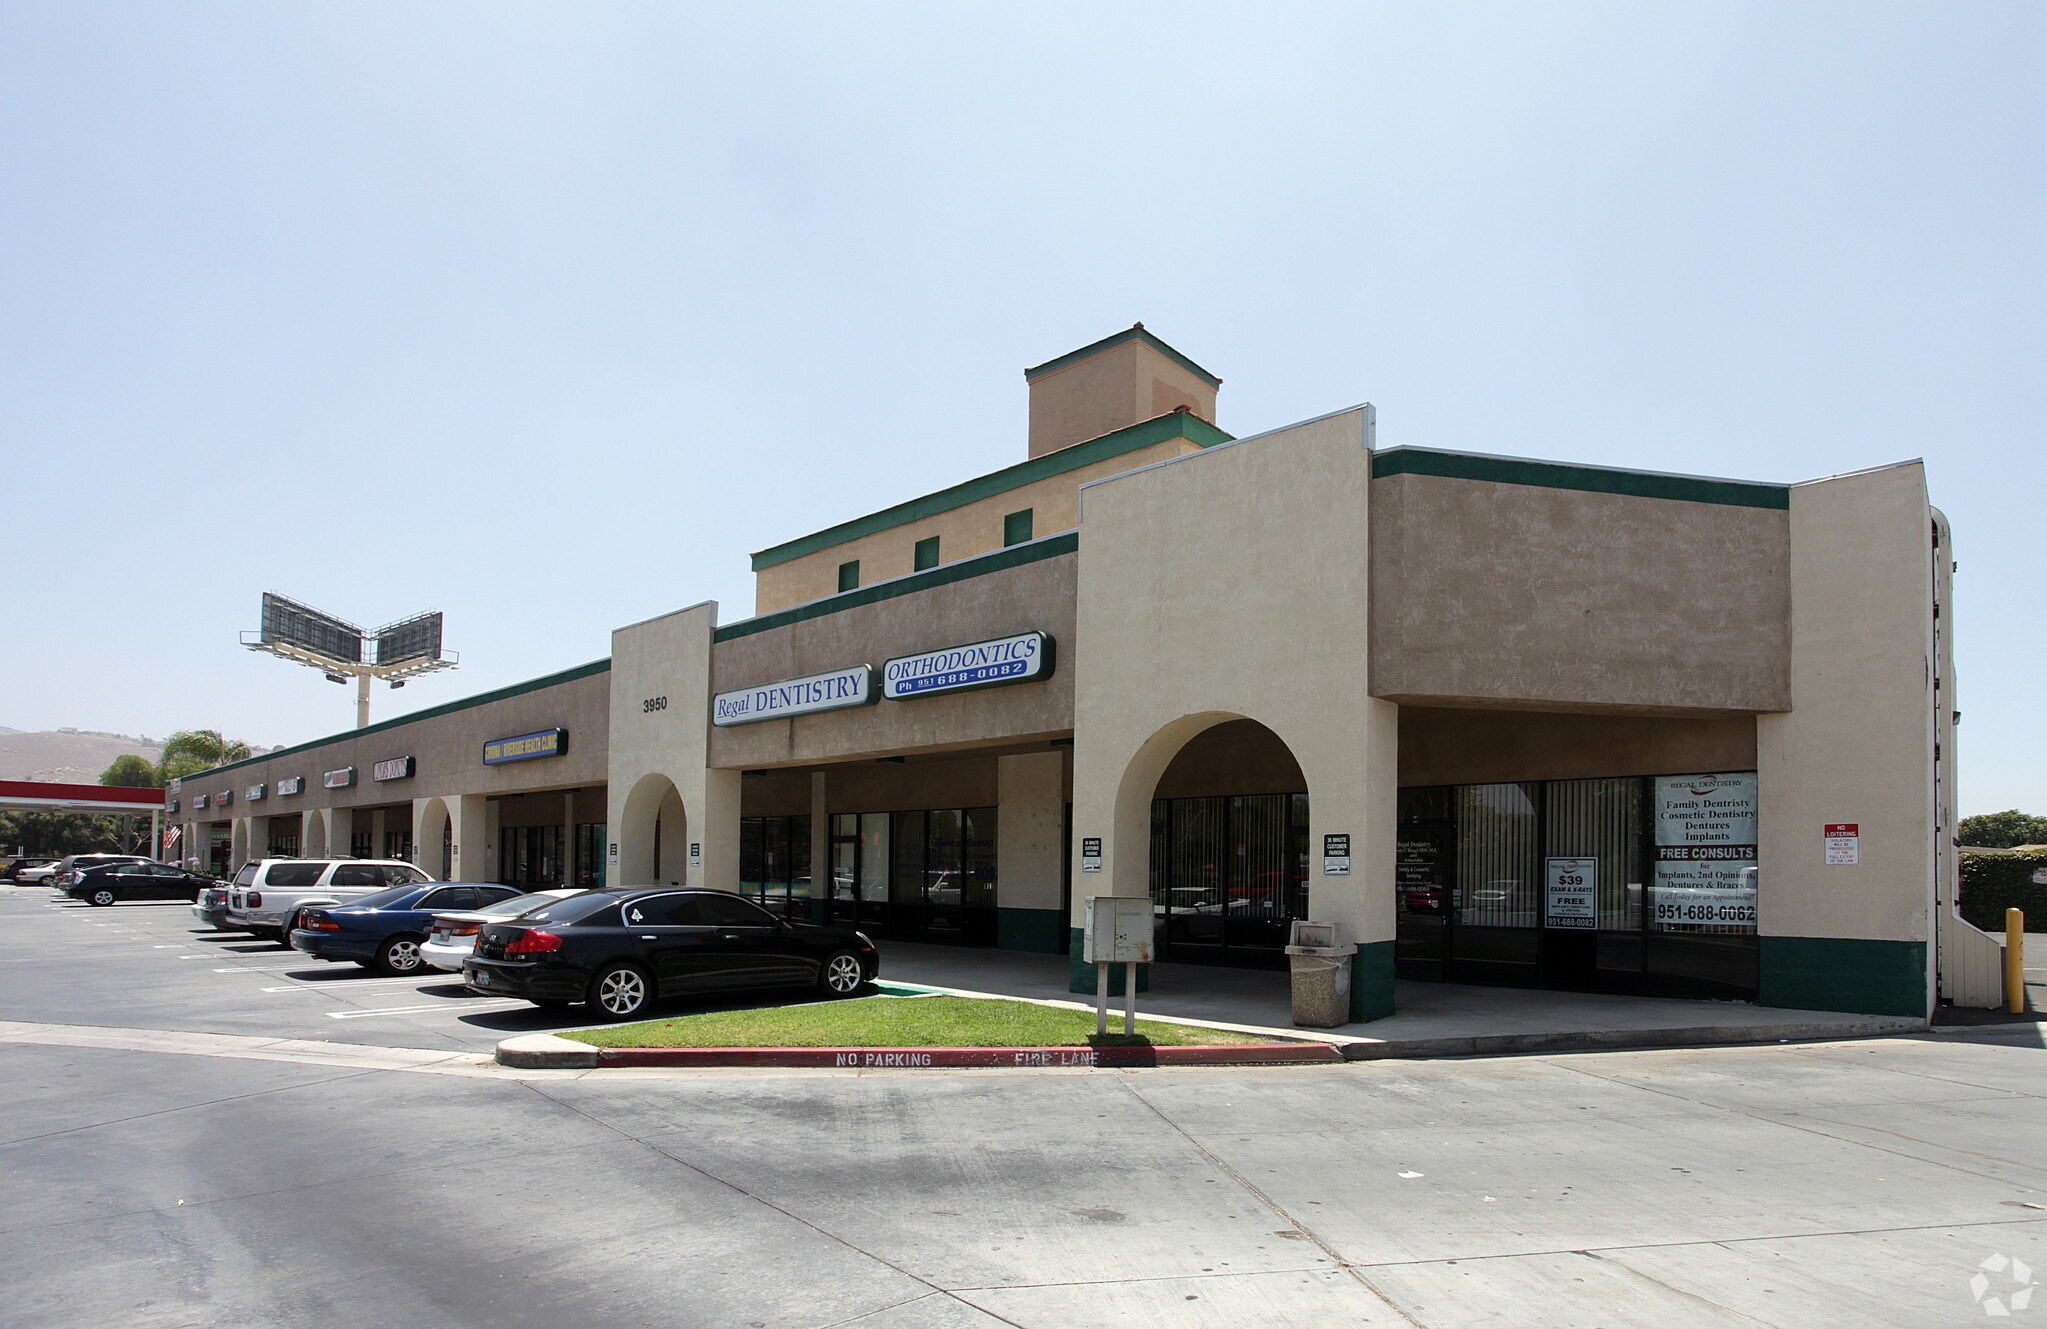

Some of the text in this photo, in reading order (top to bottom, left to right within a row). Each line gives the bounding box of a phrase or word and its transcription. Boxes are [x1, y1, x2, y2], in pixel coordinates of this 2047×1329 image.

[888, 638, 1037, 681] ORTHODONTICS
[899, 662, 1023, 692] Ph 951 688-0082
[717, 673, 862, 718] Regal DENTISTRY
[643, 696, 668, 713] 3950
[503, 740, 525, 757] RIVERSIDE
[525, 737, 541, 754] HEALTH
[541, 734, 557, 751] CLINIC
[1666, 799, 1750, 810] Family Dentristy
[1661, 810, 1755, 820] Cosmetic Dentistry
[1685, 822, 1730, 830] Dentures
[1685, 832, 1730, 842] Implants
[1660, 847, 1754, 859] FREE CONSULTS
[1559, 876, 1583, 885] $39
[1658, 871, 1756, 880] Implants, 2nd Opinions,
[1667, 881, 1704, 889] Dentures
[1674, 893, 1691, 902] Today
[1692, 893, 1702, 902] for
[1548, 918, 1594, 927] 951-688-0082
[836, 1052, 932, 1067] NO PARKING
[1014, 1052, 1100, 1066] FIRE LANE
